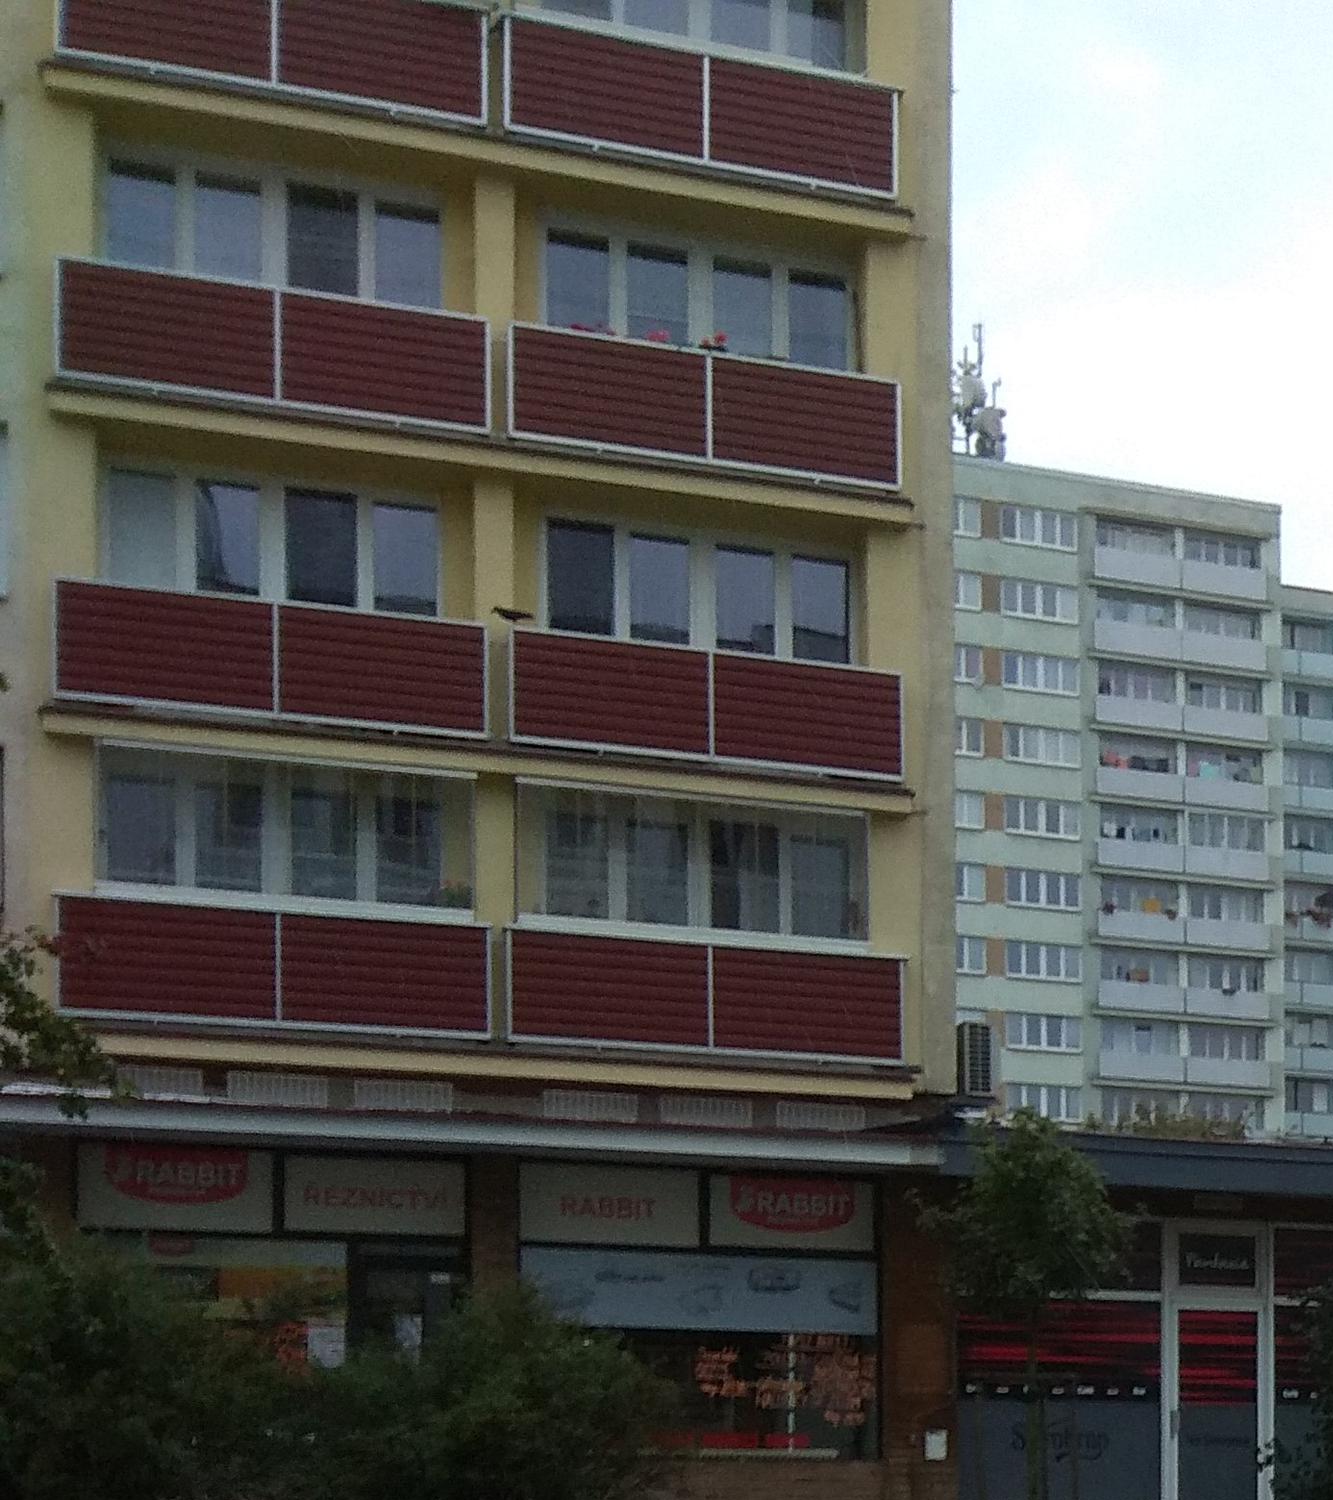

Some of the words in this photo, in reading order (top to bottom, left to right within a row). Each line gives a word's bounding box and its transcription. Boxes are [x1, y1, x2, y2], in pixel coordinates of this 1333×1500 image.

[136, 1159, 242, 1188] RABBIT
[558, 1192, 657, 1222] RABBIT
[757, 1190, 850, 1219] RABBIT
